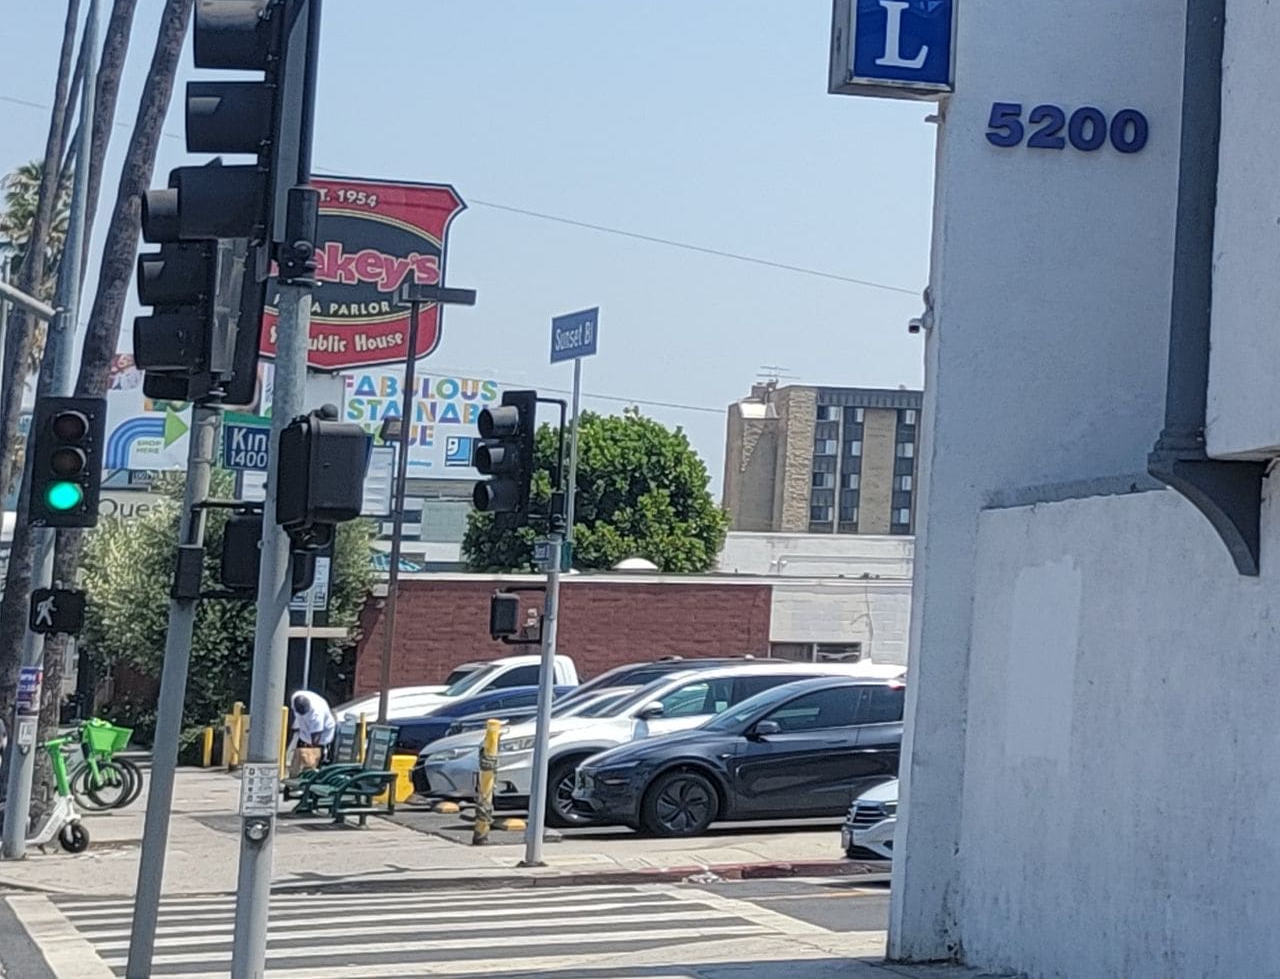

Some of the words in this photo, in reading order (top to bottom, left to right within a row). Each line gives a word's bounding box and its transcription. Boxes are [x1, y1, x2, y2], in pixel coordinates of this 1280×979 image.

[984, 101, 1149, 154] 5200
[338, 189, 378, 208] 1954
[314, 242, 441, 292] key's
[329, 300, 391, 316] PARLOR
[354, 332, 404, 352] House
[230, 450, 268, 468] 1400
